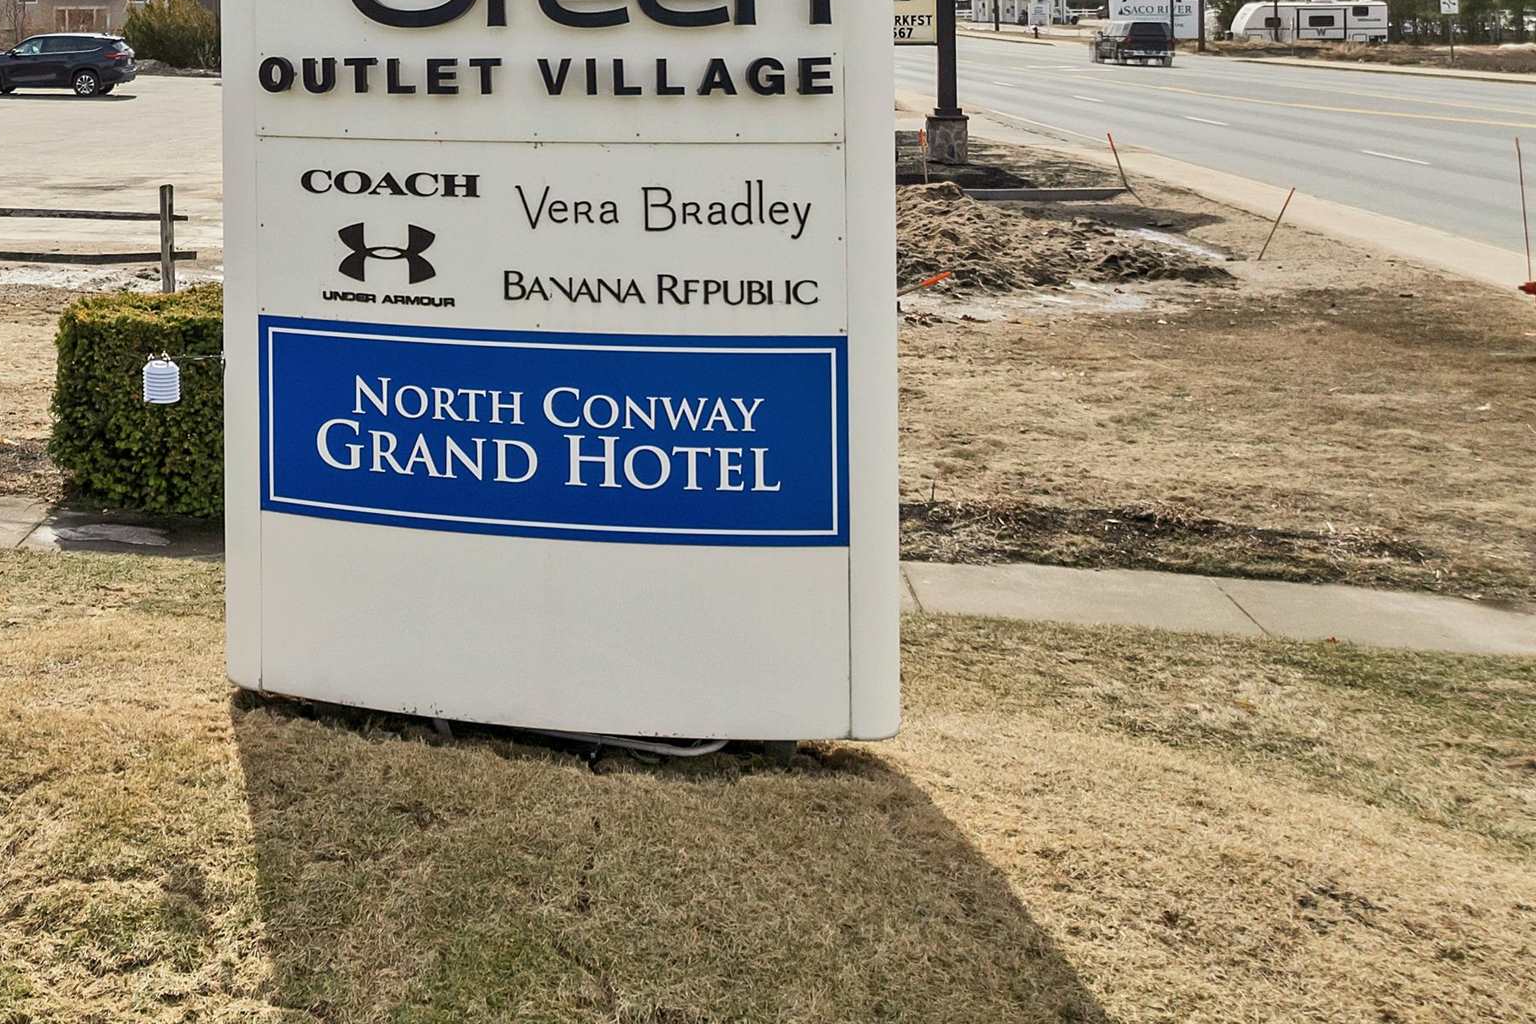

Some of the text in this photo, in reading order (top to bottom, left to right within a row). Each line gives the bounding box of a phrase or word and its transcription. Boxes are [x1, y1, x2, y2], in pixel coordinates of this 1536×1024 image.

[894, 15, 932, 26] RKFST
[1157, 5, 1192, 14] RIER
[258, 56, 835, 97] OUTLET VILLAGE
[300, 168, 481, 198] COACH
[514, 179, 814, 240] Vera Bradley
[322, 290, 456, 308] UNDER ARMOUR
[351, 374, 766, 434] NORTH CONWAY
[315, 418, 783, 493] GRAND HOTEL
